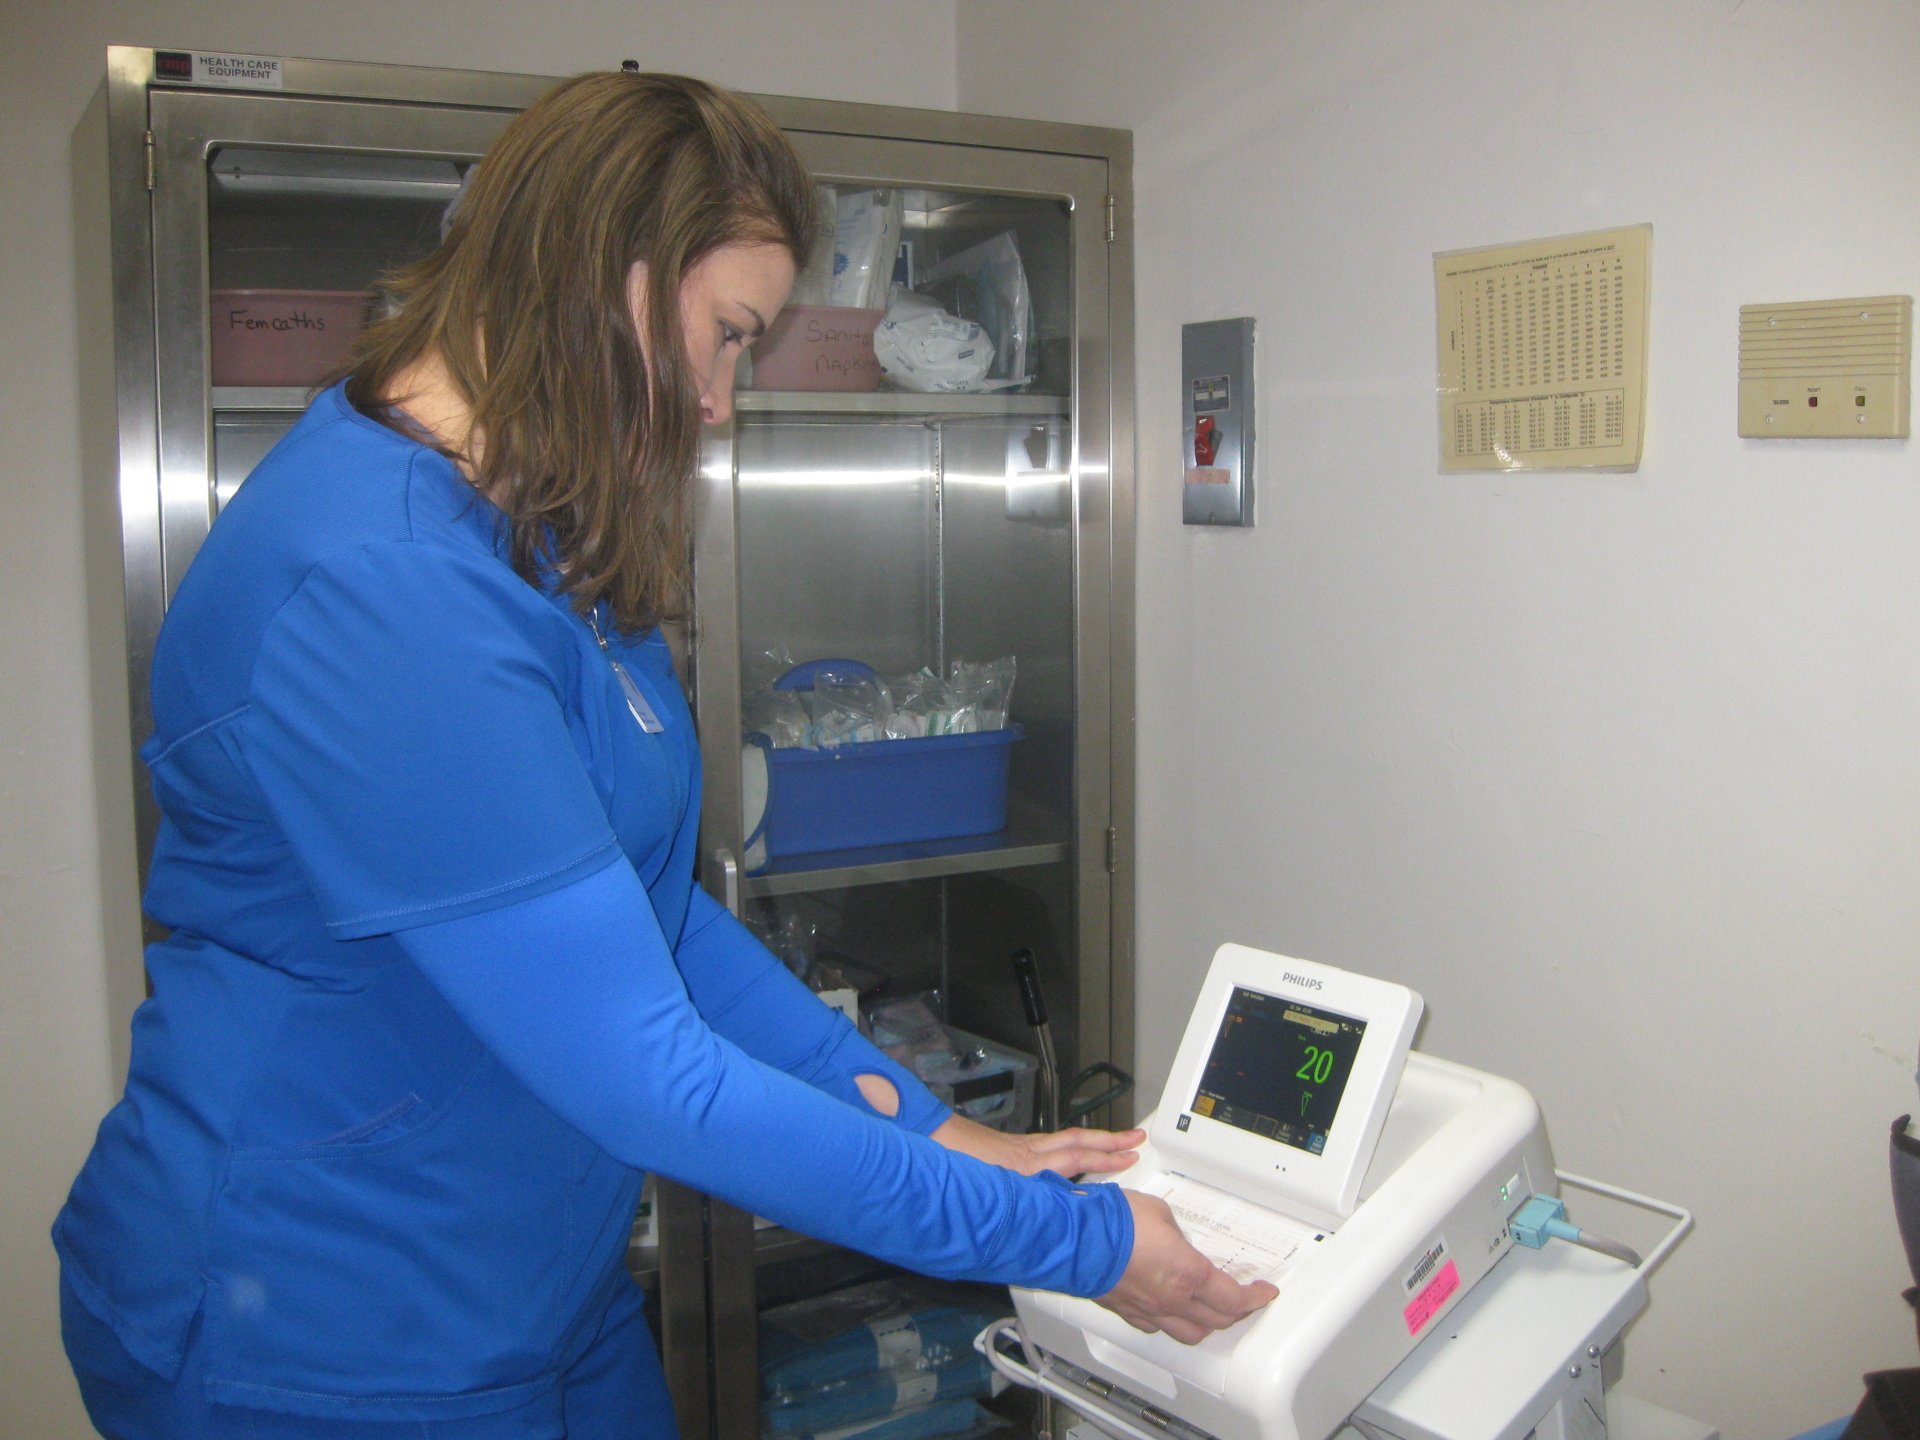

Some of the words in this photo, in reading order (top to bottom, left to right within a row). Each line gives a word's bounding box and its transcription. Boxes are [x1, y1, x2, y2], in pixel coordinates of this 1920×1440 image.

[199, 56, 245, 68] HEALTH
[247, 60, 279, 71] CARE
[208, 67, 272, 79] EQUIPMENT
[230, 309, 326, 331] Femcaths
[1282, 972, 1323, 991] PHILIPS
[1296, 1046, 1333, 1083] 20
